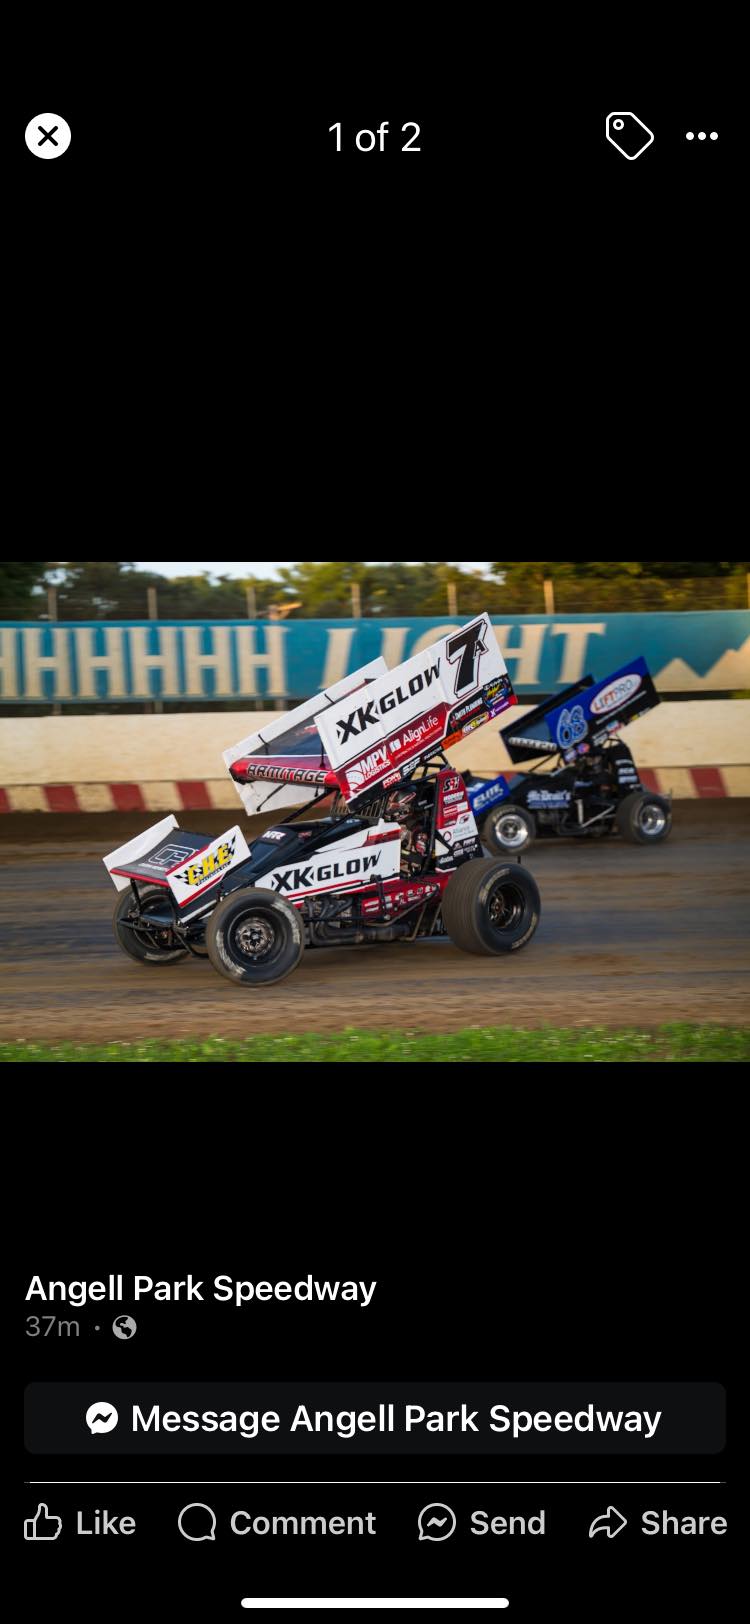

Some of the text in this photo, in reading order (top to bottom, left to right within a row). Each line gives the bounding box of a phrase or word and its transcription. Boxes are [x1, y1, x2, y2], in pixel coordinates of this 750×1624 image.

[403, 716, 438, 746] AlignLife
[361, 745, 388, 773] MPV
[364, 759, 391, 780] LOGISTICS
[248, 765, 328, 784] ARMITAGE
